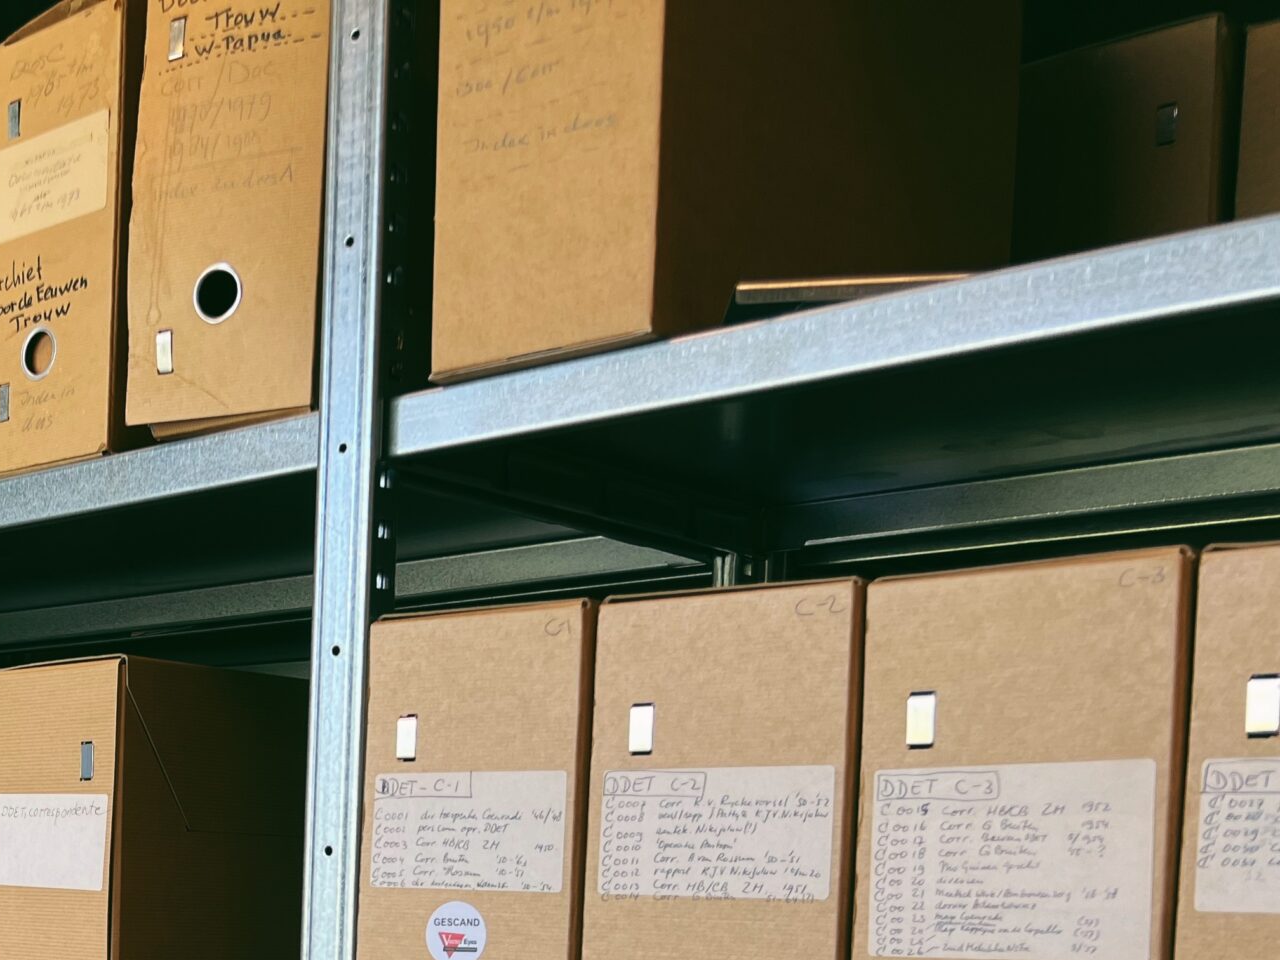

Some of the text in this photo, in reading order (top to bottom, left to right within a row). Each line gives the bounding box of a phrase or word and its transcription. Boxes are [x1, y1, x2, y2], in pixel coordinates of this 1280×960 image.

[36, 277, 88, 301] Eeuwen
[9, 301, 71, 334] Trouw
[607, 775, 701, 794] DDET C-2
[881, 778, 994, 799] DDET C-3
[1207, 770, 1276, 791] DDET
[434, 918, 480, 927] GESCAND
